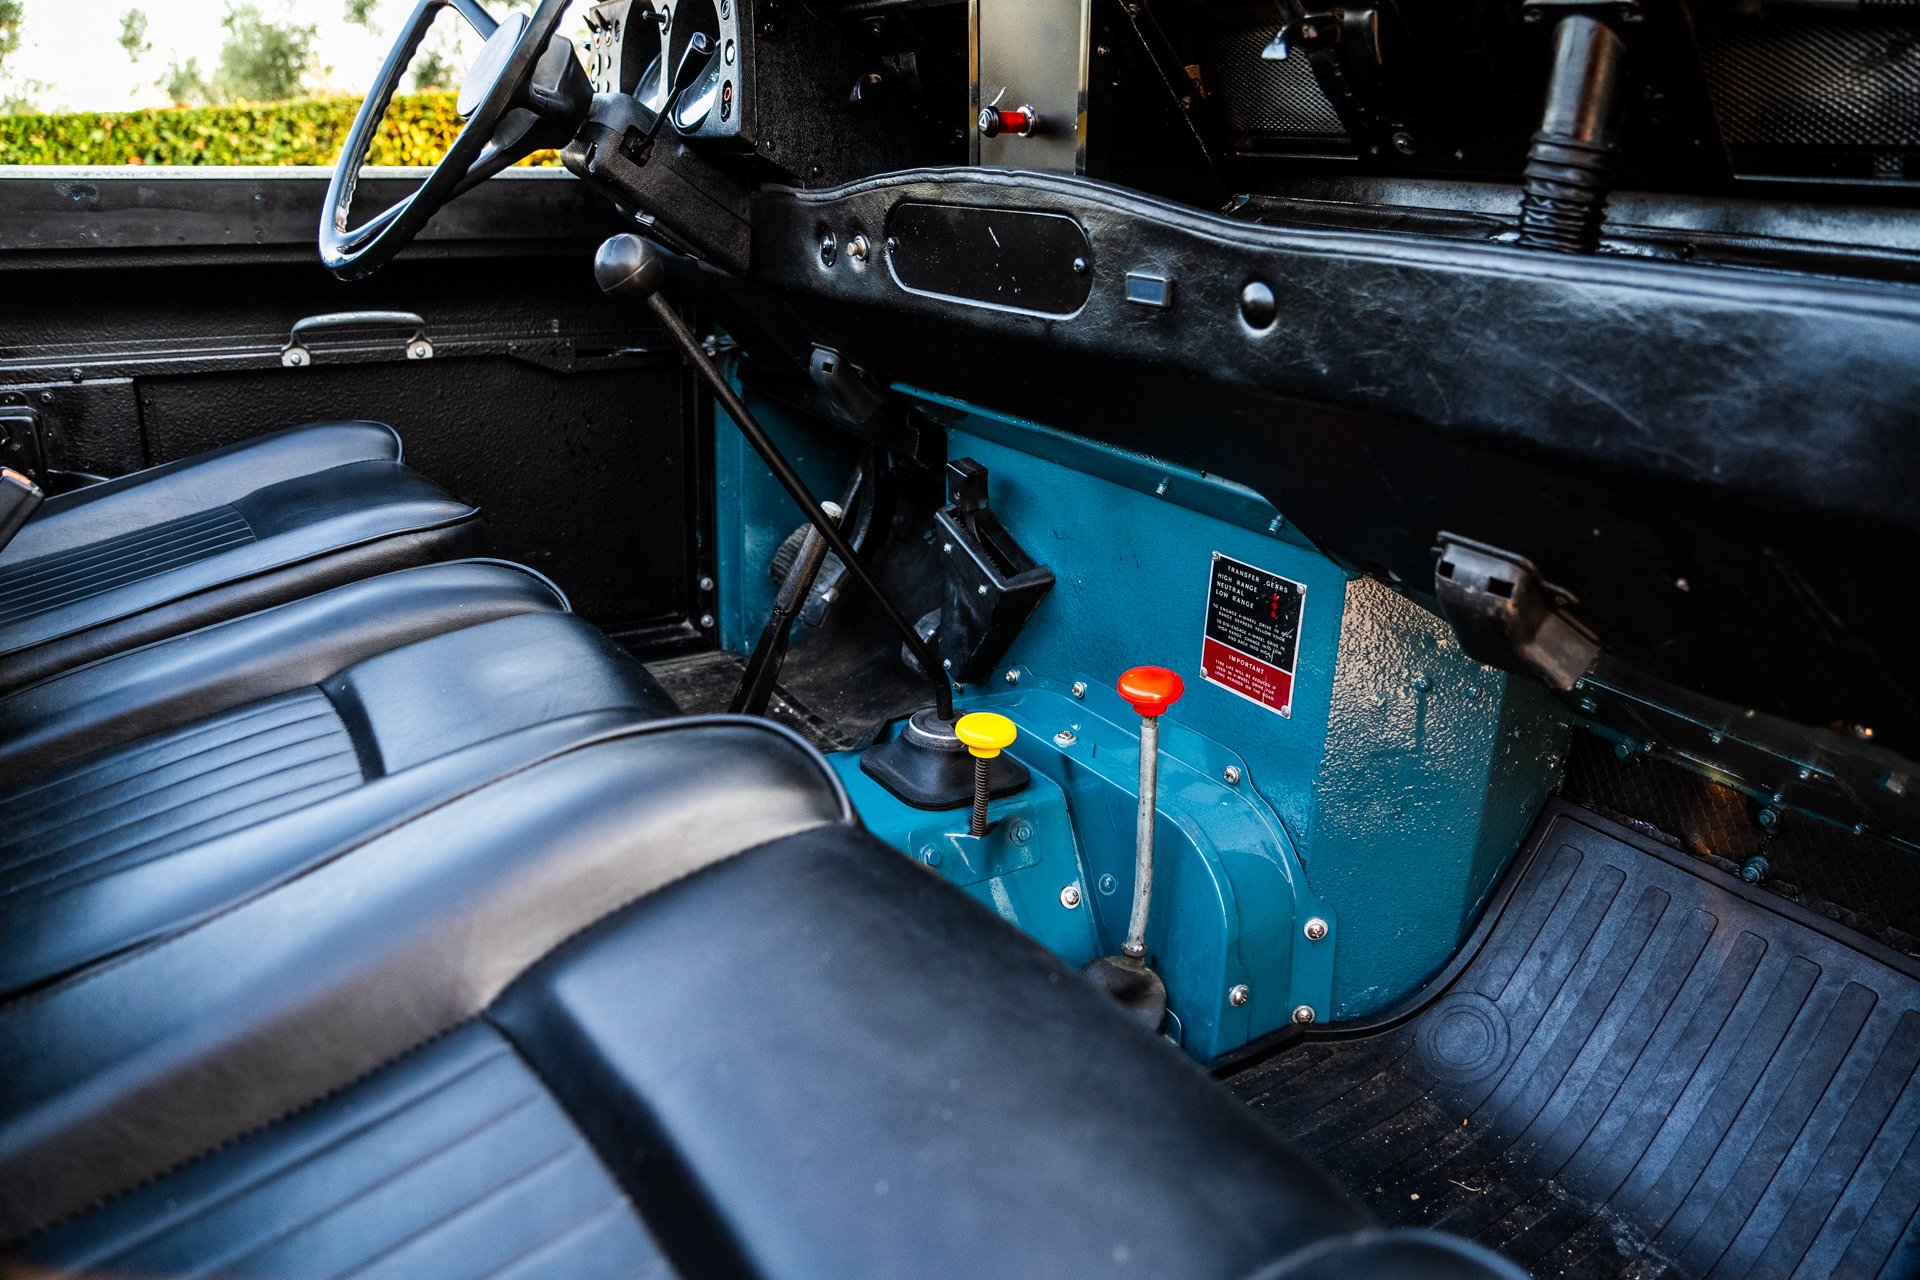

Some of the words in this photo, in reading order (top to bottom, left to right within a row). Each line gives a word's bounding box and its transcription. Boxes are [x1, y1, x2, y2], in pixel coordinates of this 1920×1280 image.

[1218, 573, 1232, 582] HIGH
[1237, 580, 1257, 592] RANGE
[1228, 566, 1259, 582] TRANSFER
[1266, 580, 1288, 593] GEARS
[1217, 581, 1244, 596] NEUTRAL
[1216, 589, 1228, 598] LOW
[1232, 596, 1254, 608] RANGE
[1219, 611, 1232, 620] RANGE
[1235, 618, 1252, 628] DEPRESS
[1255, 626, 1271, 636] YELLOW
[1220, 606, 1236, 616] ENGAGE
[1259, 622, 1271, 630] DRIVE
[1244, 636, 1260, 646] CHANGE
[1267, 640, 1278, 648] DRIVE
[1229, 654, 1264, 674] IMPORTANT
[1227, 676, 1243, 686] PERIODS
[1252, 676, 1270, 687] REDUCED
[1252, 682, 1263, 690] DRIVE
